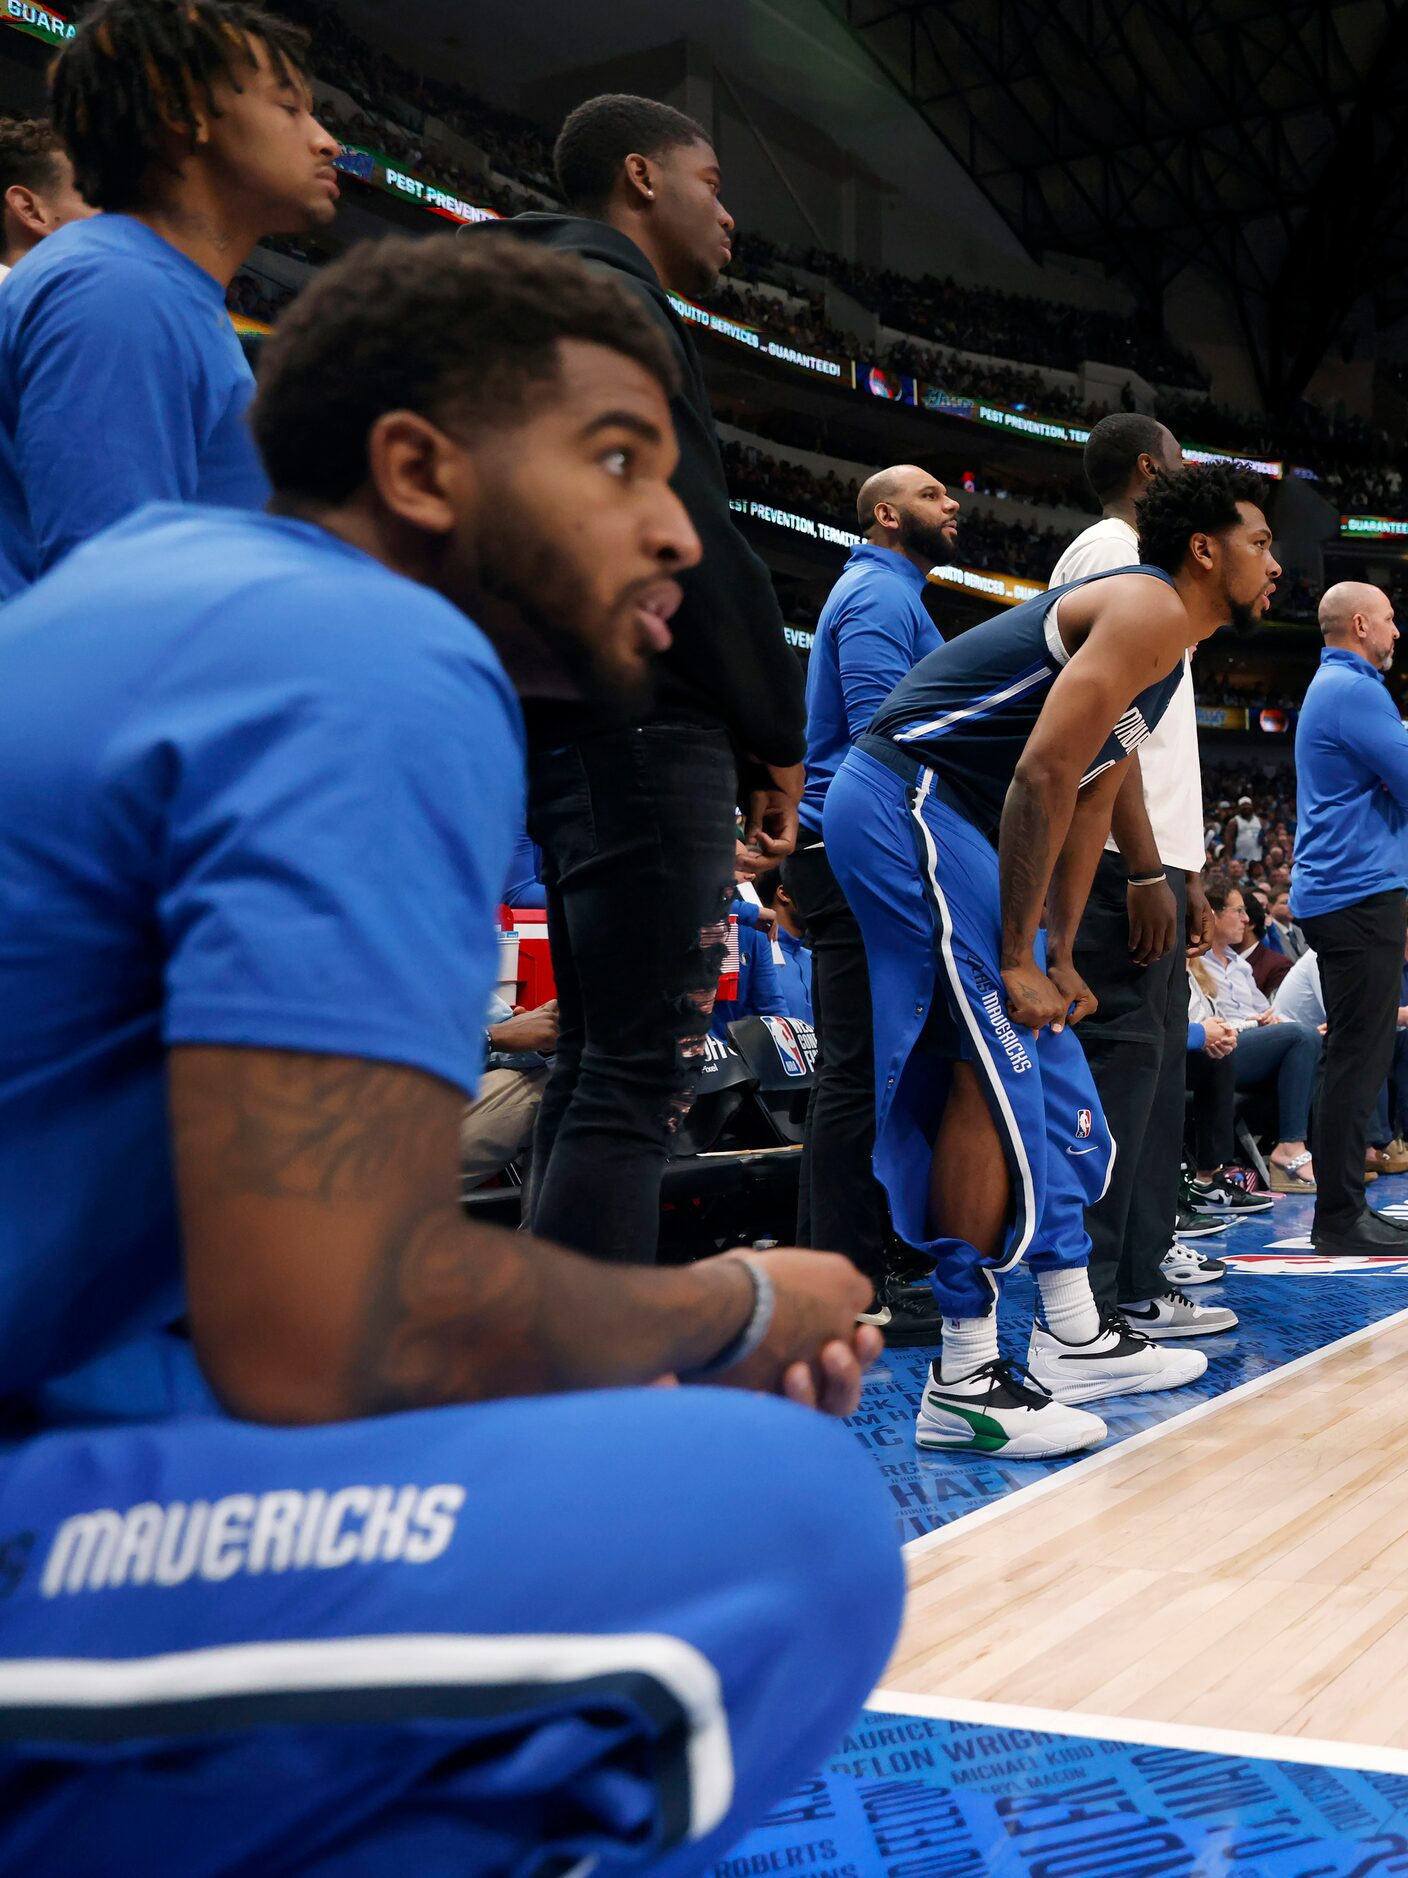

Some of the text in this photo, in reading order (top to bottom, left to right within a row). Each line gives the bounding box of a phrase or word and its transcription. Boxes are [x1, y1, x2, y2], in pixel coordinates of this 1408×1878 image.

[385, 167, 425, 198] PEST
[709, 315, 760, 349] SERVICES
[768, 341, 841, 377] GUARANTEED!
[979, 405, 1004, 424] PEST
[1004, 415, 1069, 441] PREVENTION,
[750, 501, 818, 539] PREVENTION,
[964, 569, 1006, 596] SERVICES
[982, 990, 1033, 1074] MAVERICKS
[41, 1484, 466, 1599] MAVERICKS
[951, 1756, 1039, 1786] MICHAEL
[1026, 1767, 1088, 1789] MACON
